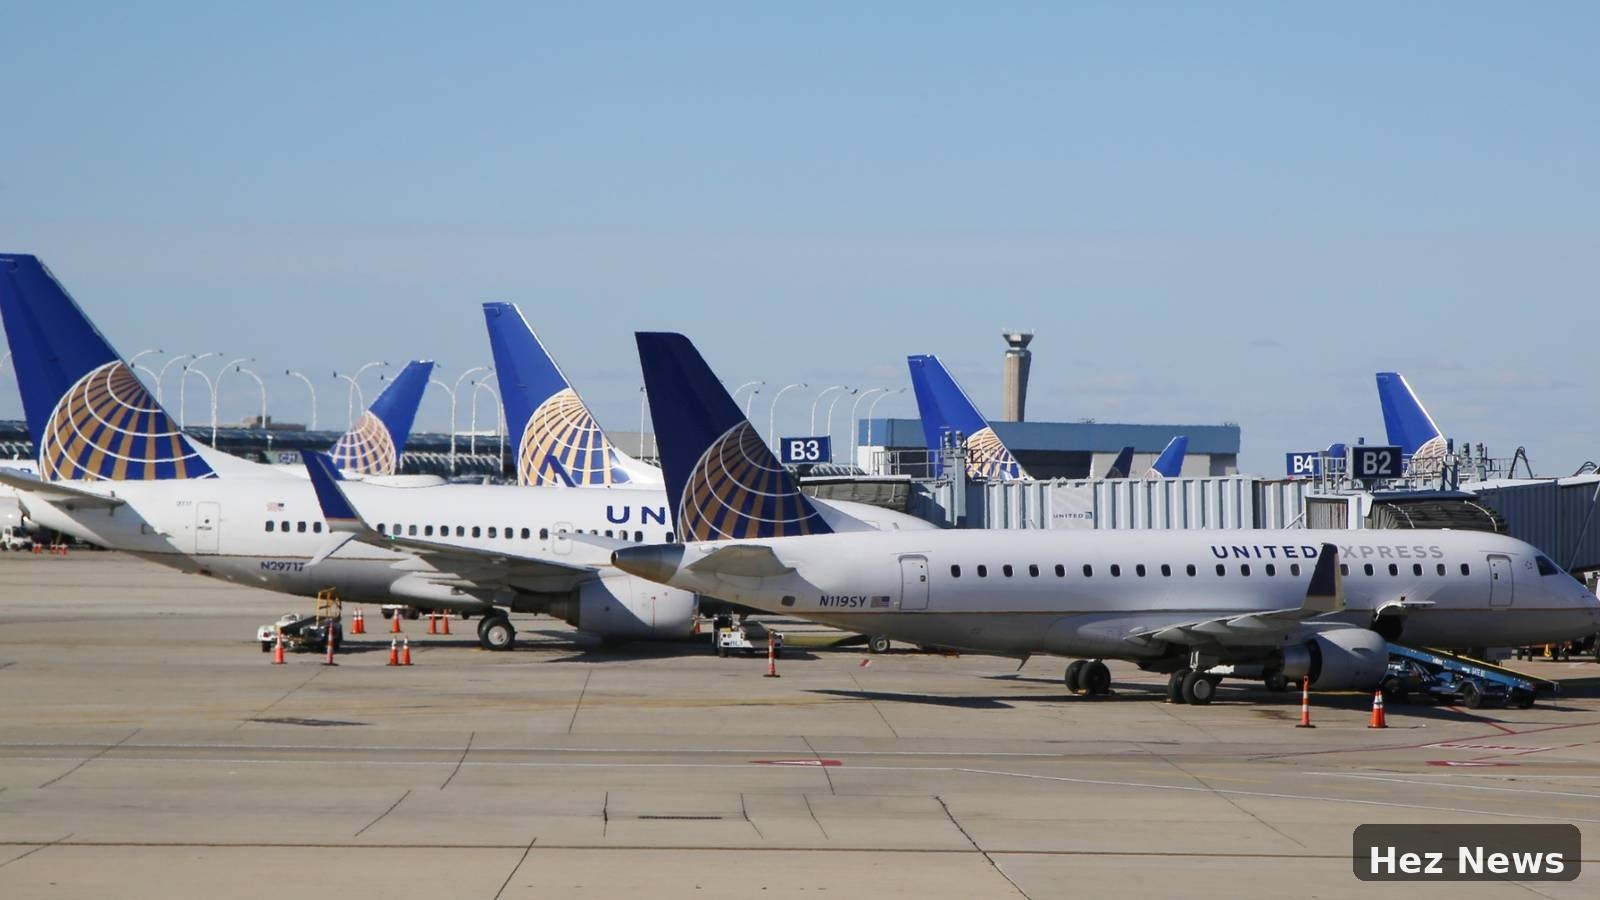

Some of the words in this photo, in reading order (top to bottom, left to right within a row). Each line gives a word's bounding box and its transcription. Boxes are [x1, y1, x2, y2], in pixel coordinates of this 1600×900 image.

[791, 440, 820, 460] B3
[1293, 455, 1314, 473] B4
[1363, 451, 1392, 475] B2
[1211, 546, 1318, 559] UNITED
[1332, 546, 1444, 559] XPRESS
[261, 561, 304, 572] N29717
[820, 595, 867, 608] N119SY
